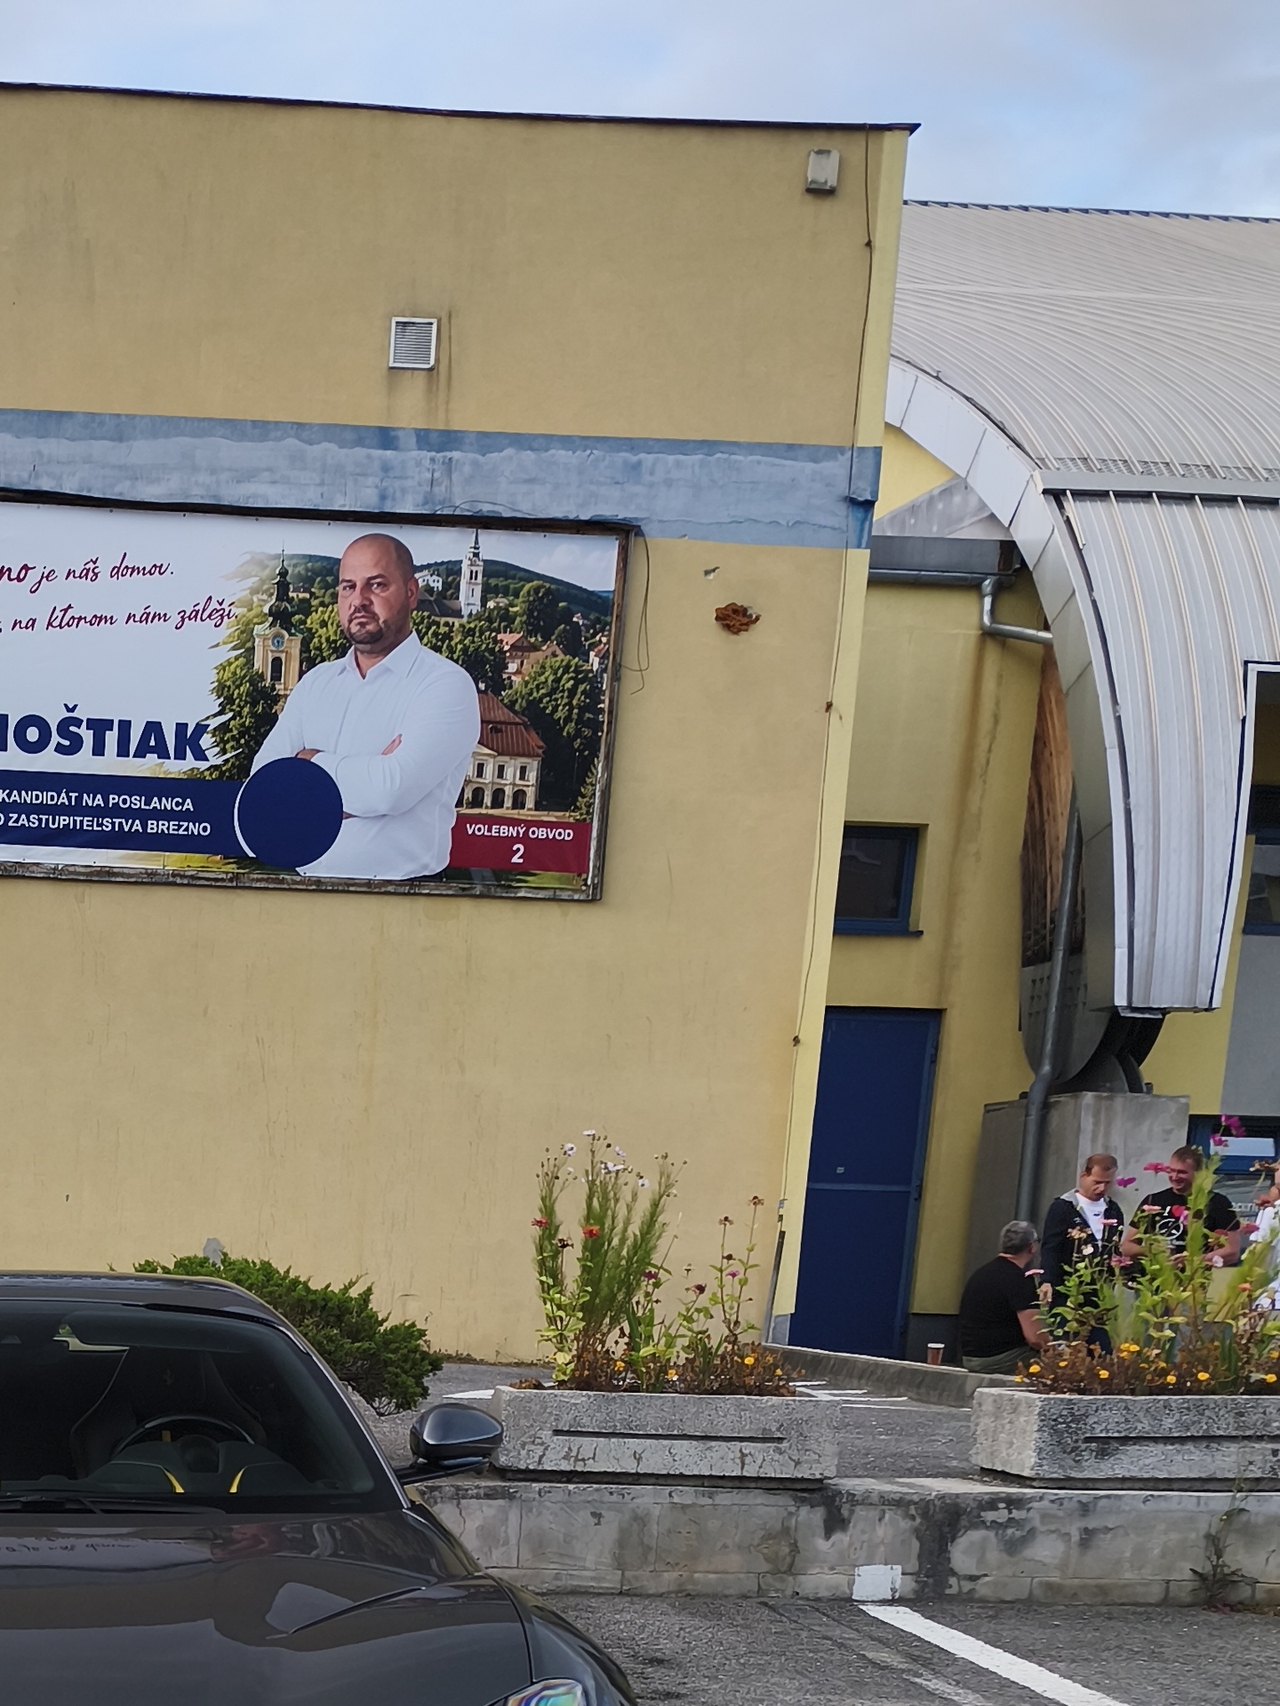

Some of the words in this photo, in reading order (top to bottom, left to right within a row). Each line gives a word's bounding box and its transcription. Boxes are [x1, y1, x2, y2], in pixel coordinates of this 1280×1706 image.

[30, 563, 58, 594] je
[65, 557, 101, 583] náš
[109, 552, 174, 579] domov.
[11, 615, 37, 632] na
[46, 603, 118, 631] ktorom
[125, 605, 172, 626] nám
[174, 595, 238, 630] záleží.
[82, 793, 105, 807] NA
[108, 795, 194, 812] POSLANCA
[8, 813, 143, 834] ZASTUPITEĽSTVA
[147, 820, 211, 837] BREZNO
[466, 823, 526, 839] VOLEBNÝ
[528, 827, 574, 841] OBVOD
[511, 844, 524, 864] 2
